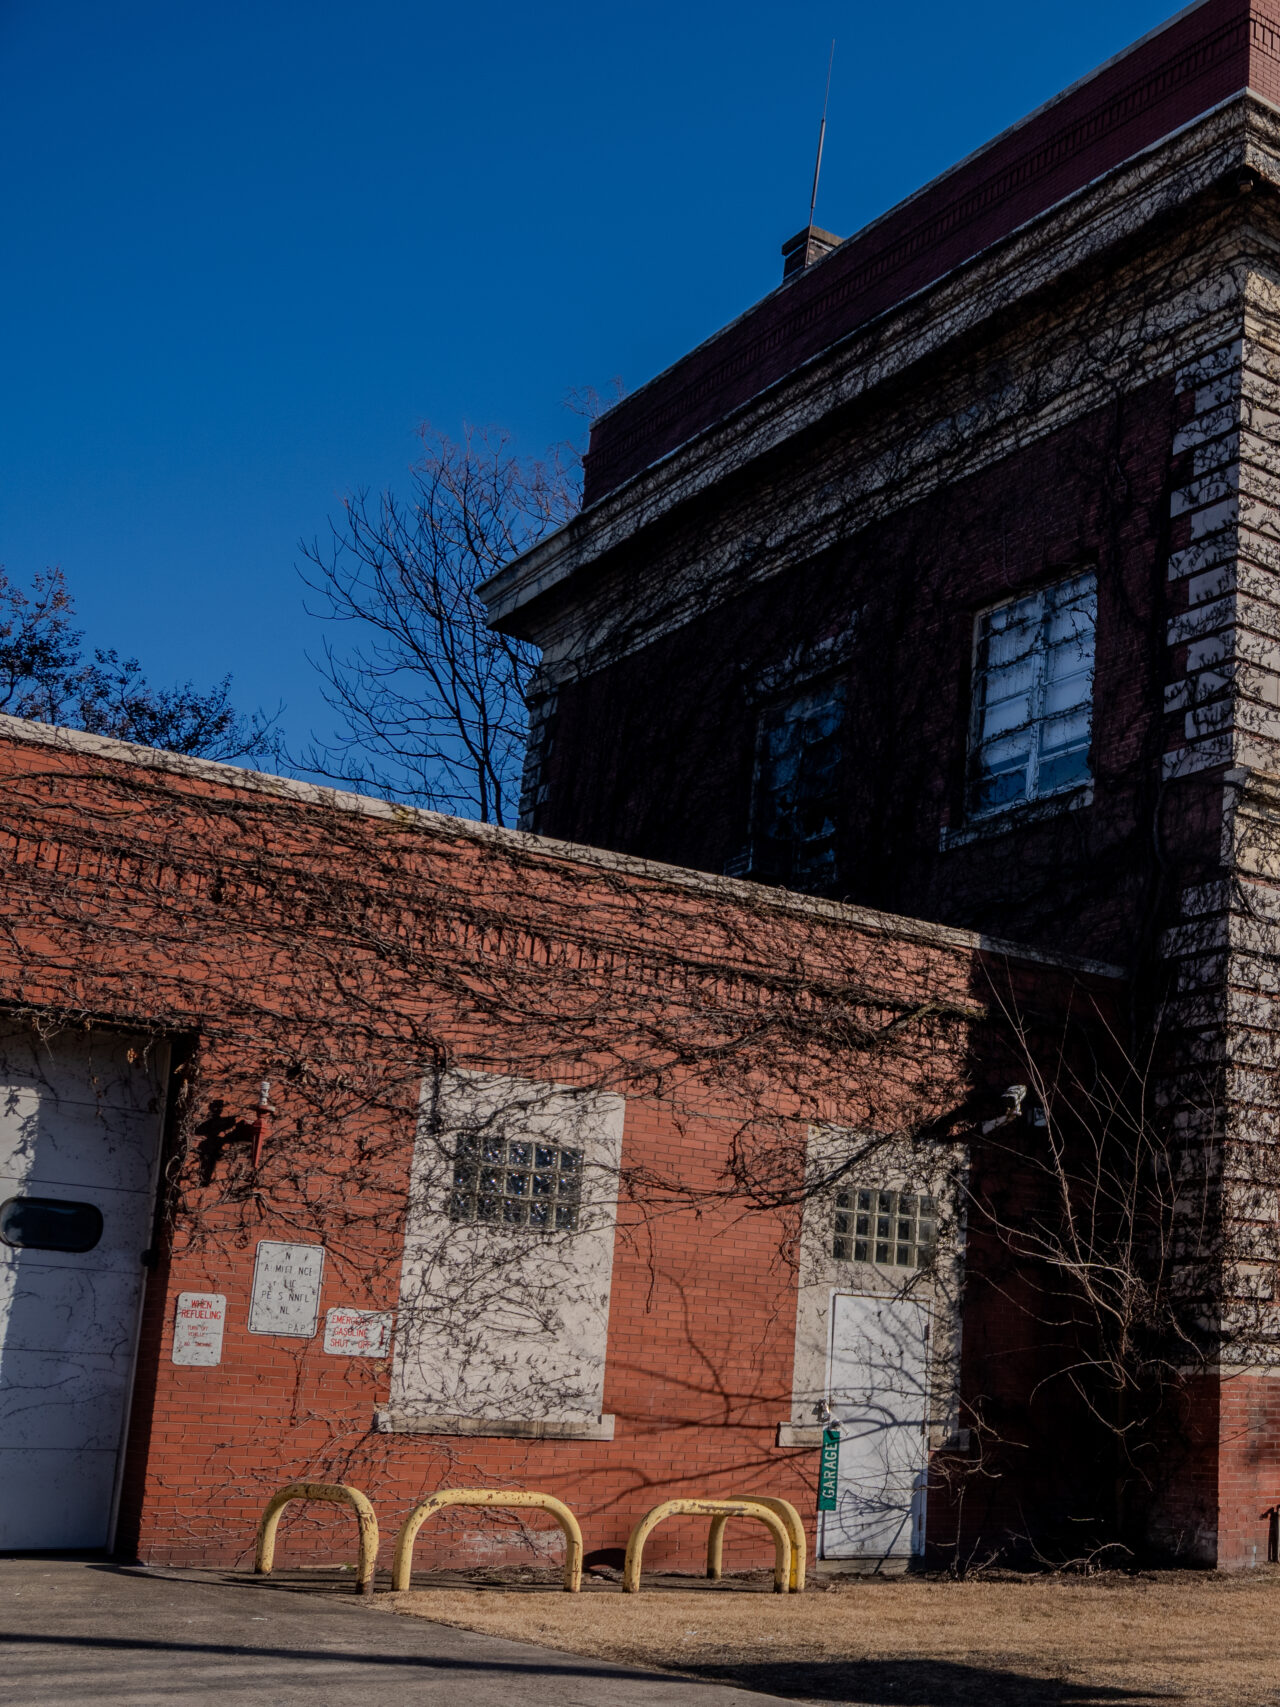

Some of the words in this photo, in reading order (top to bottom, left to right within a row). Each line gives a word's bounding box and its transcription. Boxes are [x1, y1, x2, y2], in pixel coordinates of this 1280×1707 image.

[191, 1299, 212, 1309] WHEN
[181, 1310, 221, 1320] REFUELING
[330, 1338, 349, 1348] SHUT
[358, 1340, 371, 1349] OFF
[822, 1442, 838, 1499] GARAGE
